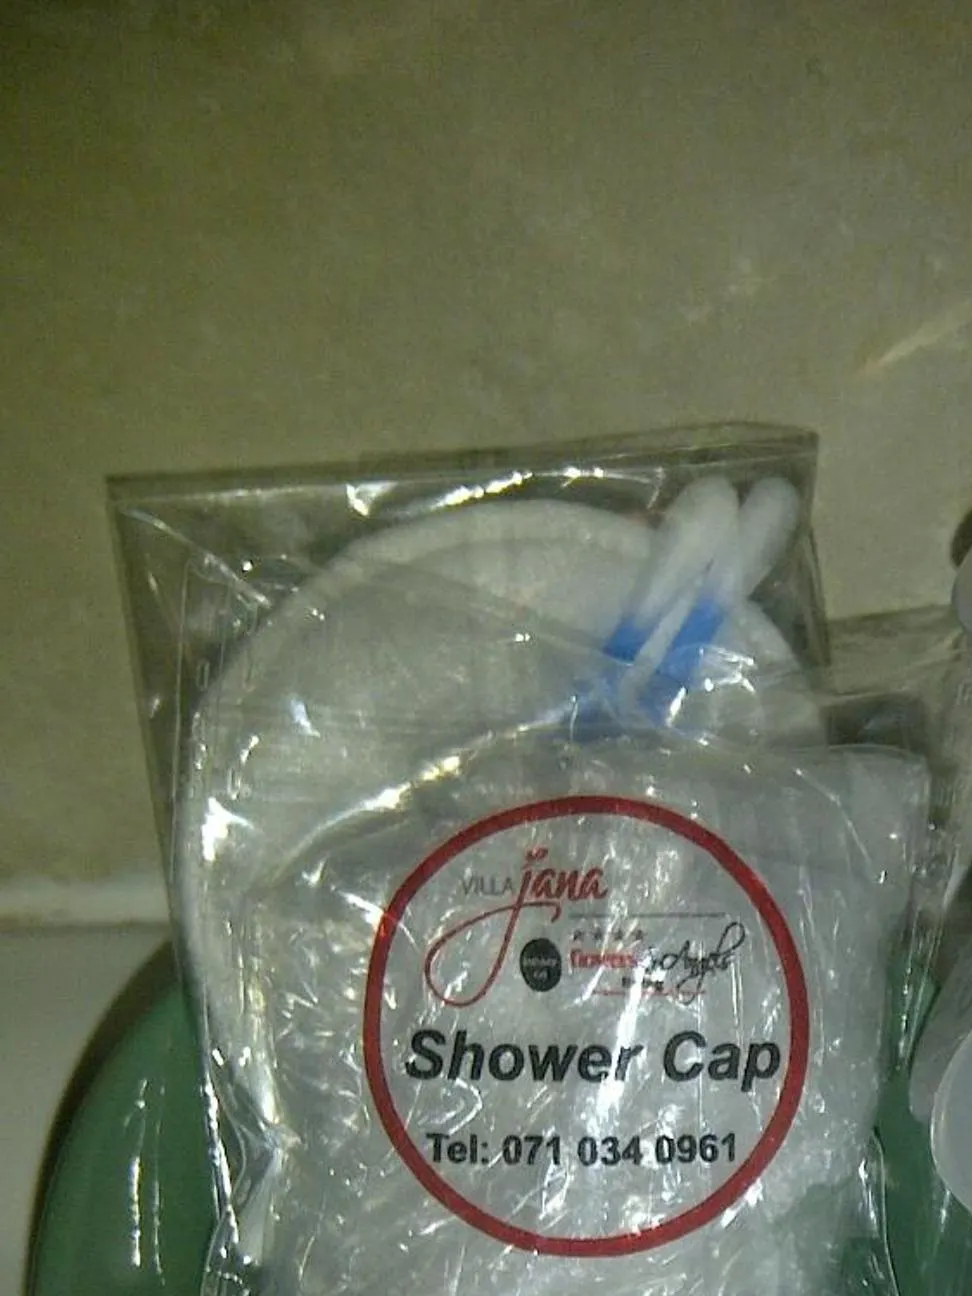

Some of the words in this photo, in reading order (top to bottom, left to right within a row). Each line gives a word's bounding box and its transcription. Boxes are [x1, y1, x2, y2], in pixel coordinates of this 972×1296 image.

[460, 873, 515, 896] VILLA
[424, 848, 609, 1007] jana
[404, 1028, 645, 1083] Shower
[662, 1029, 781, 1093] Cap
[425, 1132, 490, 1166] Tel:
[501, 1133, 563, 1166] 071
[576, 1133, 644, 1167] 034
[654, 1131, 737, 1165] 0961
